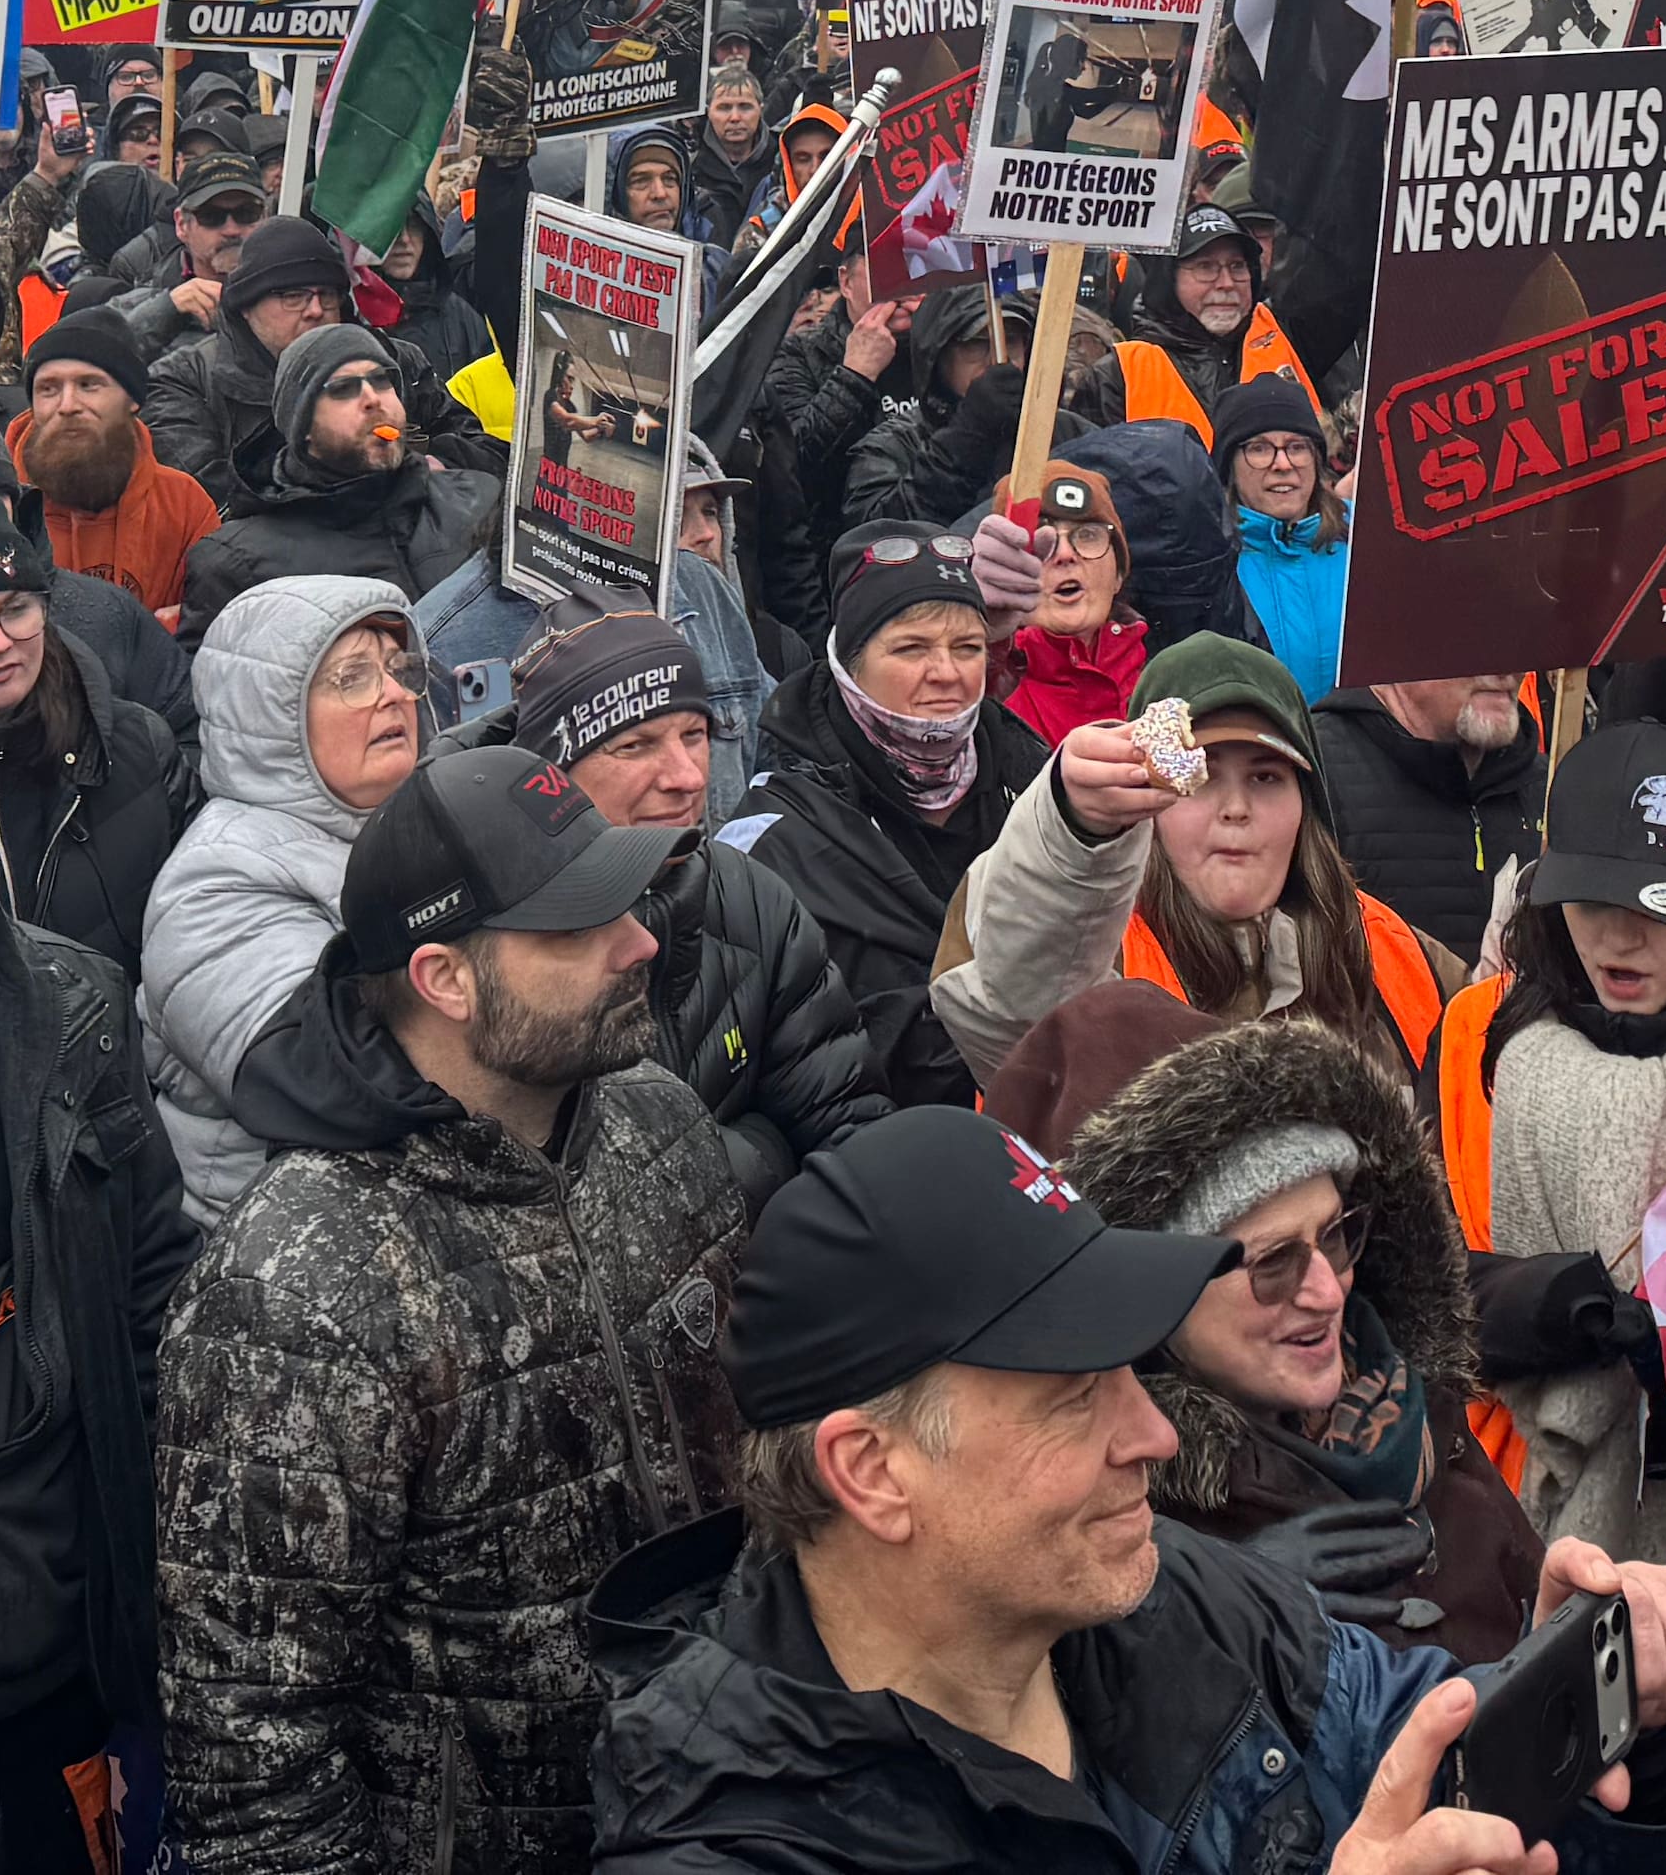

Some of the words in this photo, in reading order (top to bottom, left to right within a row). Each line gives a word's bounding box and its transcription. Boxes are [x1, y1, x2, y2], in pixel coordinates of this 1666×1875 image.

[188, 5, 245, 36] OUI
[250, 13, 288, 35] AU
[293, 9, 349, 38] BON
[533, 79, 555, 103] LA
[558, 60, 667, 98] CONFISCATION
[607, 80, 677, 111] PERSONNE
[878, 110, 937, 153] NOT
[1398, 95, 1499, 182] MES
[1501, 87, 1664, 176] ARMES
[998, 157, 1158, 198] PROTÉGEONS
[988, 190, 1072, 226] NOTRE
[1076, 197, 1156, 229] SPORT
[1391, 179, 1450, 254] NE
[1451, 176, 1564, 250] SONT
[1563, 171, 1644, 243] PAS
[537, 223, 569, 256] MON
[570, 236, 623, 282] SPORT
[624, 251, 676, 297] N'EST
[544, 262, 573, 296] PAS
[574, 272, 598, 309] UN
[600, 280, 660, 327] CRIME
[1409, 365, 1531, 443] NOT
[533, 483, 579, 528] NOTRE
[579, 504, 636, 547] SPORT
[601, 557, 617, 573] un
[572, 704, 590, 727] le
[591, 664, 682, 715] coureur
[577, 687, 671, 749] nordique
[406, 889, 463, 929] HOYT
[1022, 1172, 1055, 1204] THE
